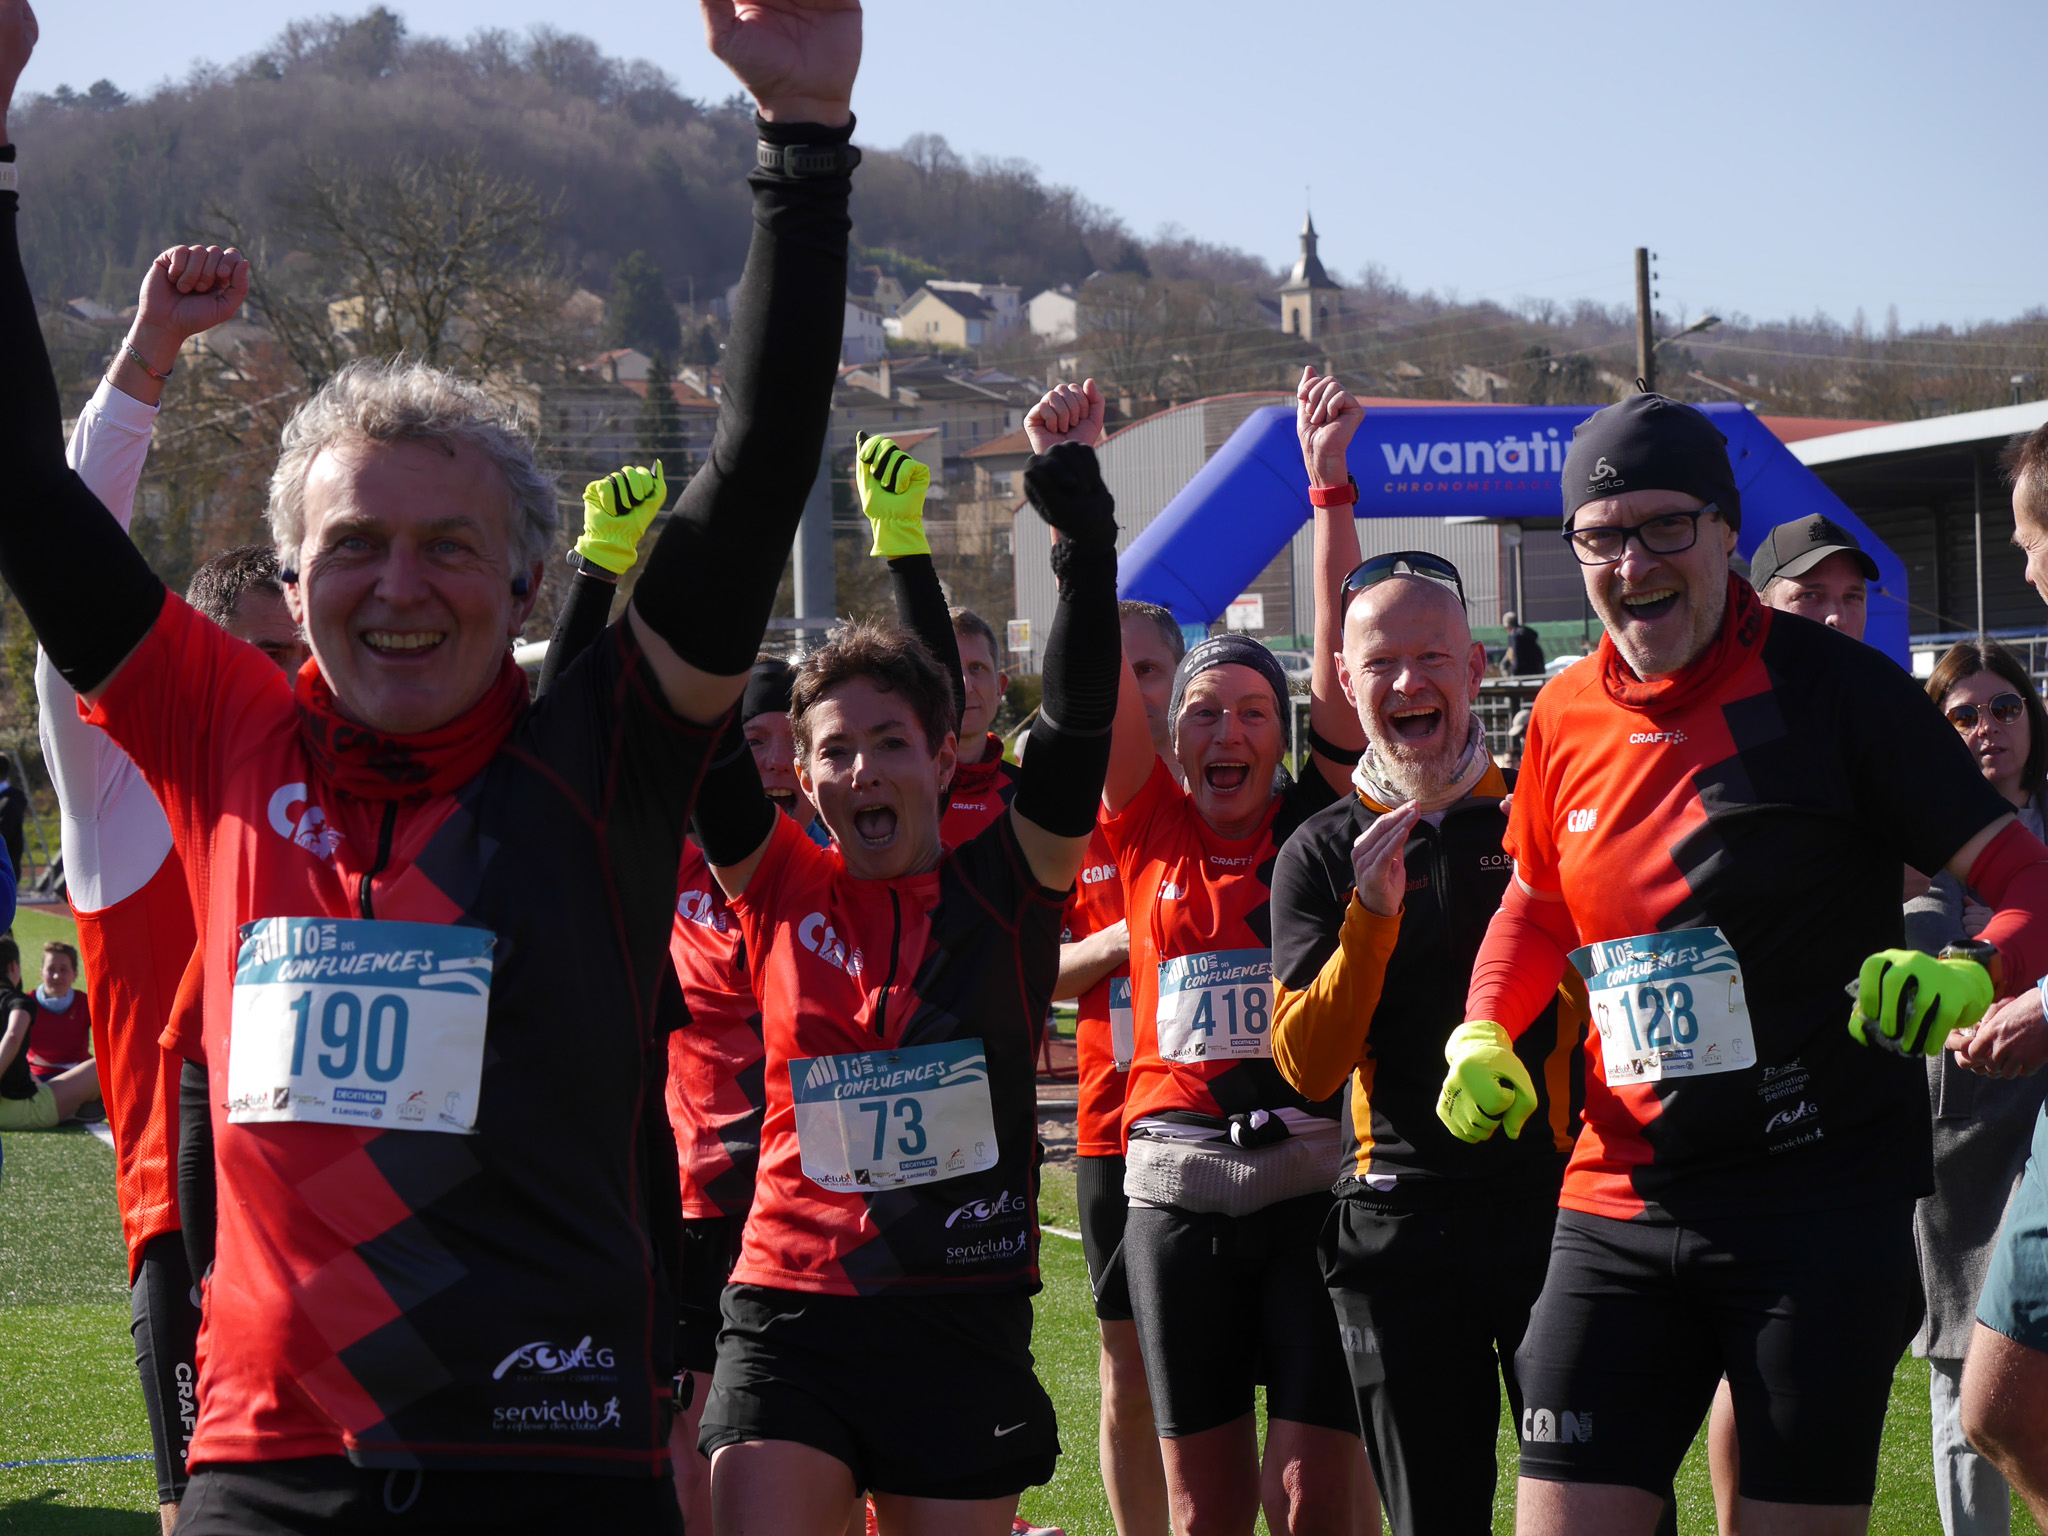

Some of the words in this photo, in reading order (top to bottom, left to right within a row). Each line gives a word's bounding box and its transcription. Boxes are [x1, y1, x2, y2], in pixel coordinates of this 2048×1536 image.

[1384, 479, 1552, 493] CHRONOMÉTRAGE
[1585, 478, 1624, 493] odlo
[1629, 732, 1673, 744] CRAFT
[952, 802, 980, 810] CRAFT
[1210, 856, 1247, 866] CRAFT
[1480, 855, 1514, 866] GOR
[293, 924, 319, 955] 10
[321, 924, 337, 951] KM
[276, 950, 434, 983] CONFLUENCES
[1191, 957, 1208, 973] 10
[1208, 954, 1219, 969] KM
[1606, 946, 1699, 988] CONFLUENCES
[1607, 943, 1625, 968] 10
[1184, 962, 1274, 990] CONFLUENCES
[1191, 986, 1269, 1037] 418
[1619, 982, 1700, 1052] 128
[289, 990, 410, 1083] 190
[841, 1058, 863, 1081] 10
[861, 1055, 874, 1075] KM
[877, 1065, 888, 1073] DES
[834, 1061, 946, 1100] CONFLUENCES
[336, 1089, 385, 1102] DECATHLON
[332, 1107, 370, 1118] E.Leclerc
[858, 1097, 928, 1162] 73
[900, 1158, 936, 1170] DECATHLON
[946, 1236, 1014, 1259] serviclub
[493, 1400, 598, 1421] serviclub
